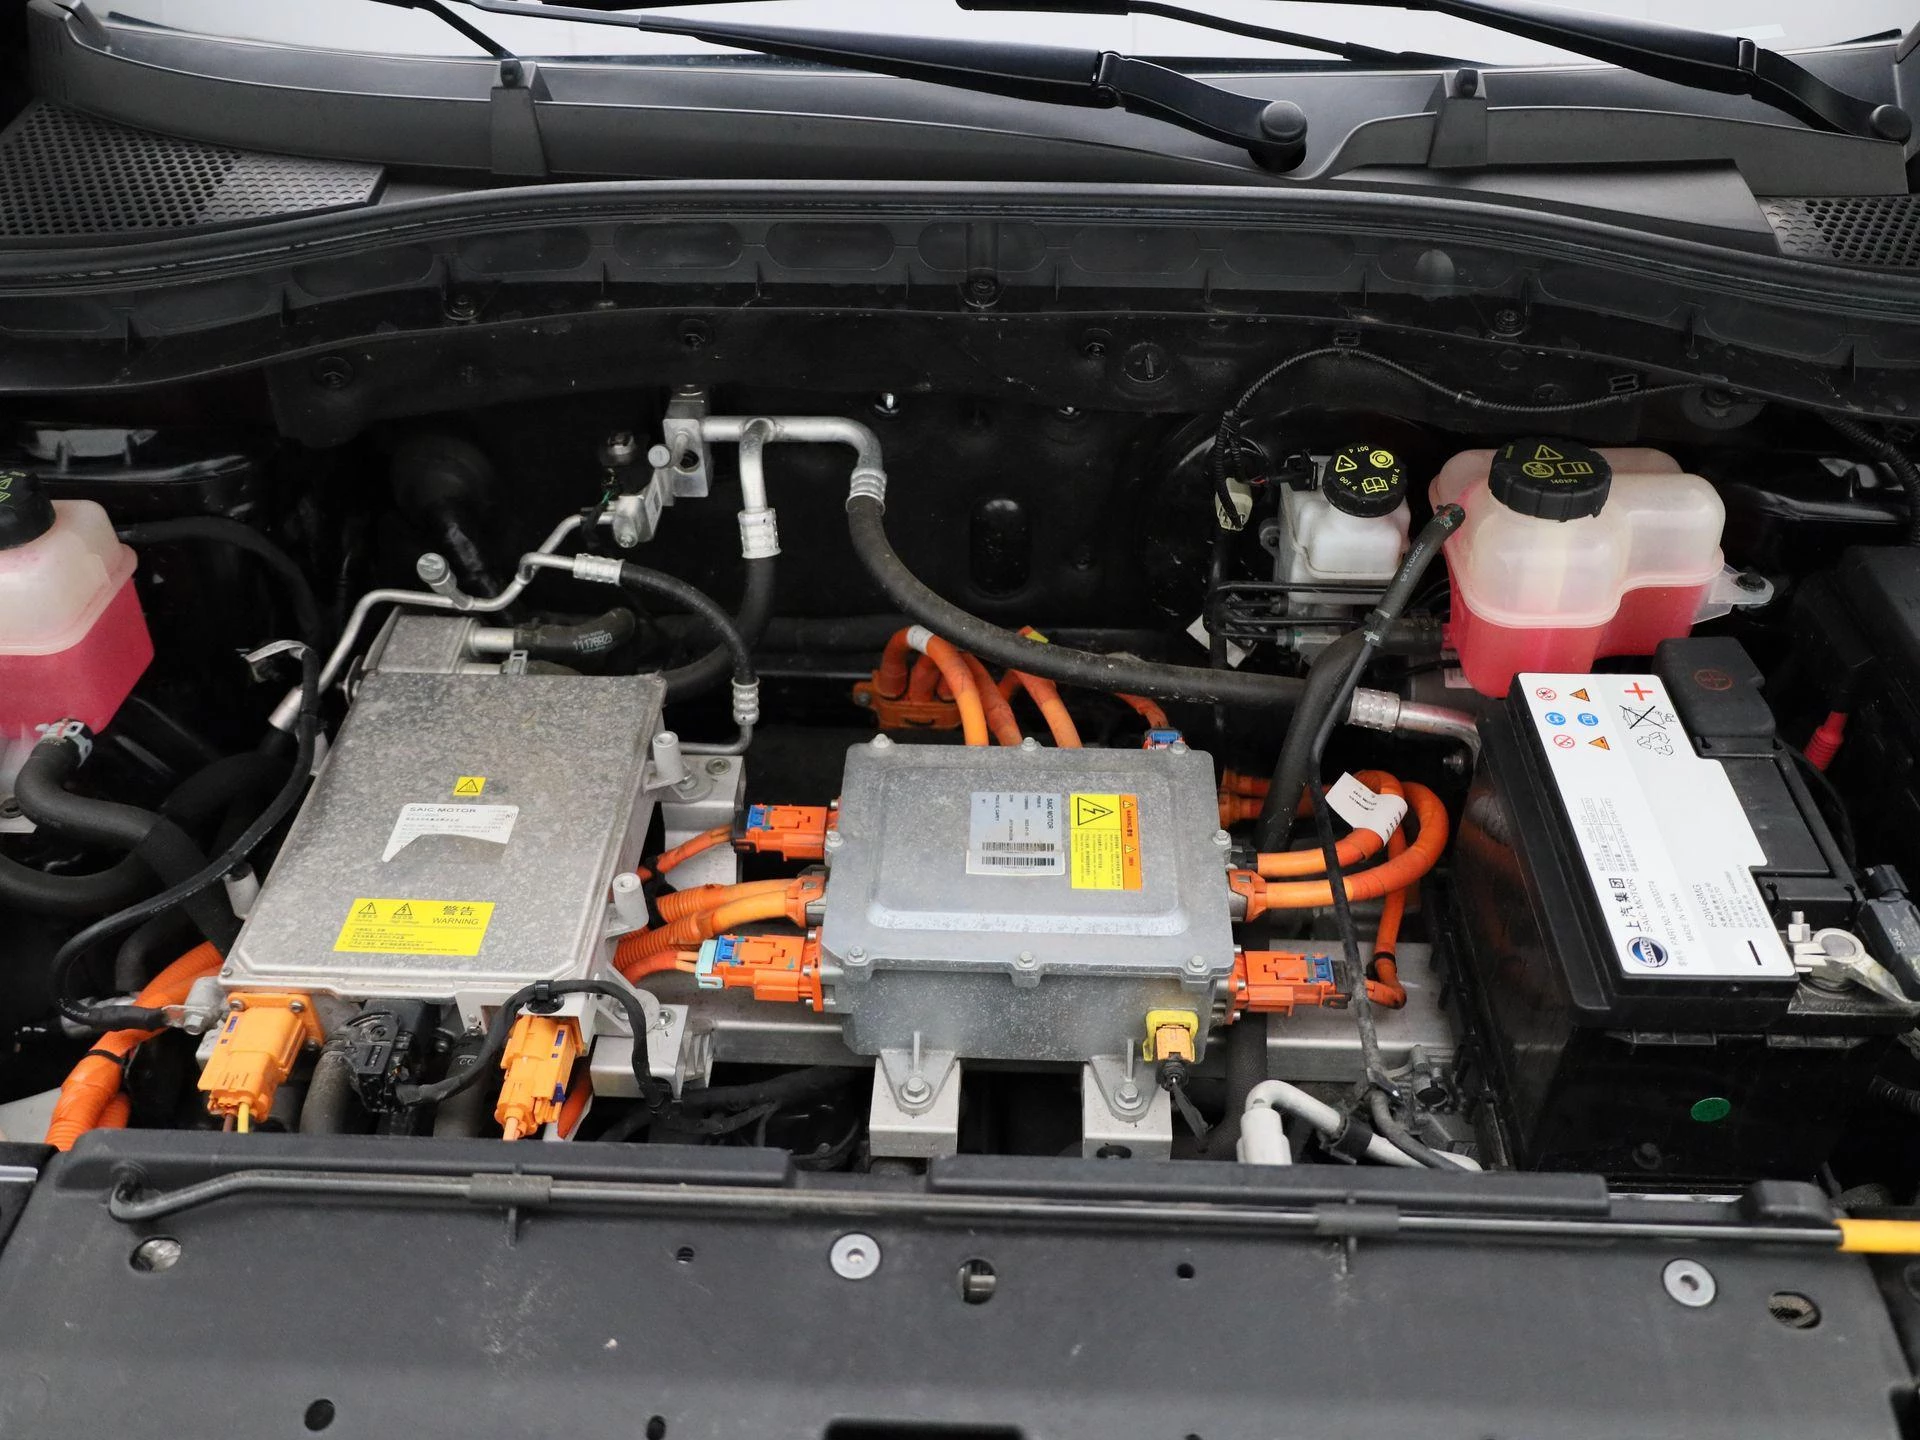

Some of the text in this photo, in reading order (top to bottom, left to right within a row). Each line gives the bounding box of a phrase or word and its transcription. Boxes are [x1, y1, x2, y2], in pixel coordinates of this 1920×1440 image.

[1339, 476, 1352, 486] DOT
[1046, 810, 1054, 830] MOTOR
[442, 904, 476, 917] 警告
[1606, 876, 1642, 932] 上汽集团
[1624, 877, 1654, 932] SAIC MOTOR
[432, 917, 479, 926] WARNING
[1639, 939, 1657, 964] SAIC
